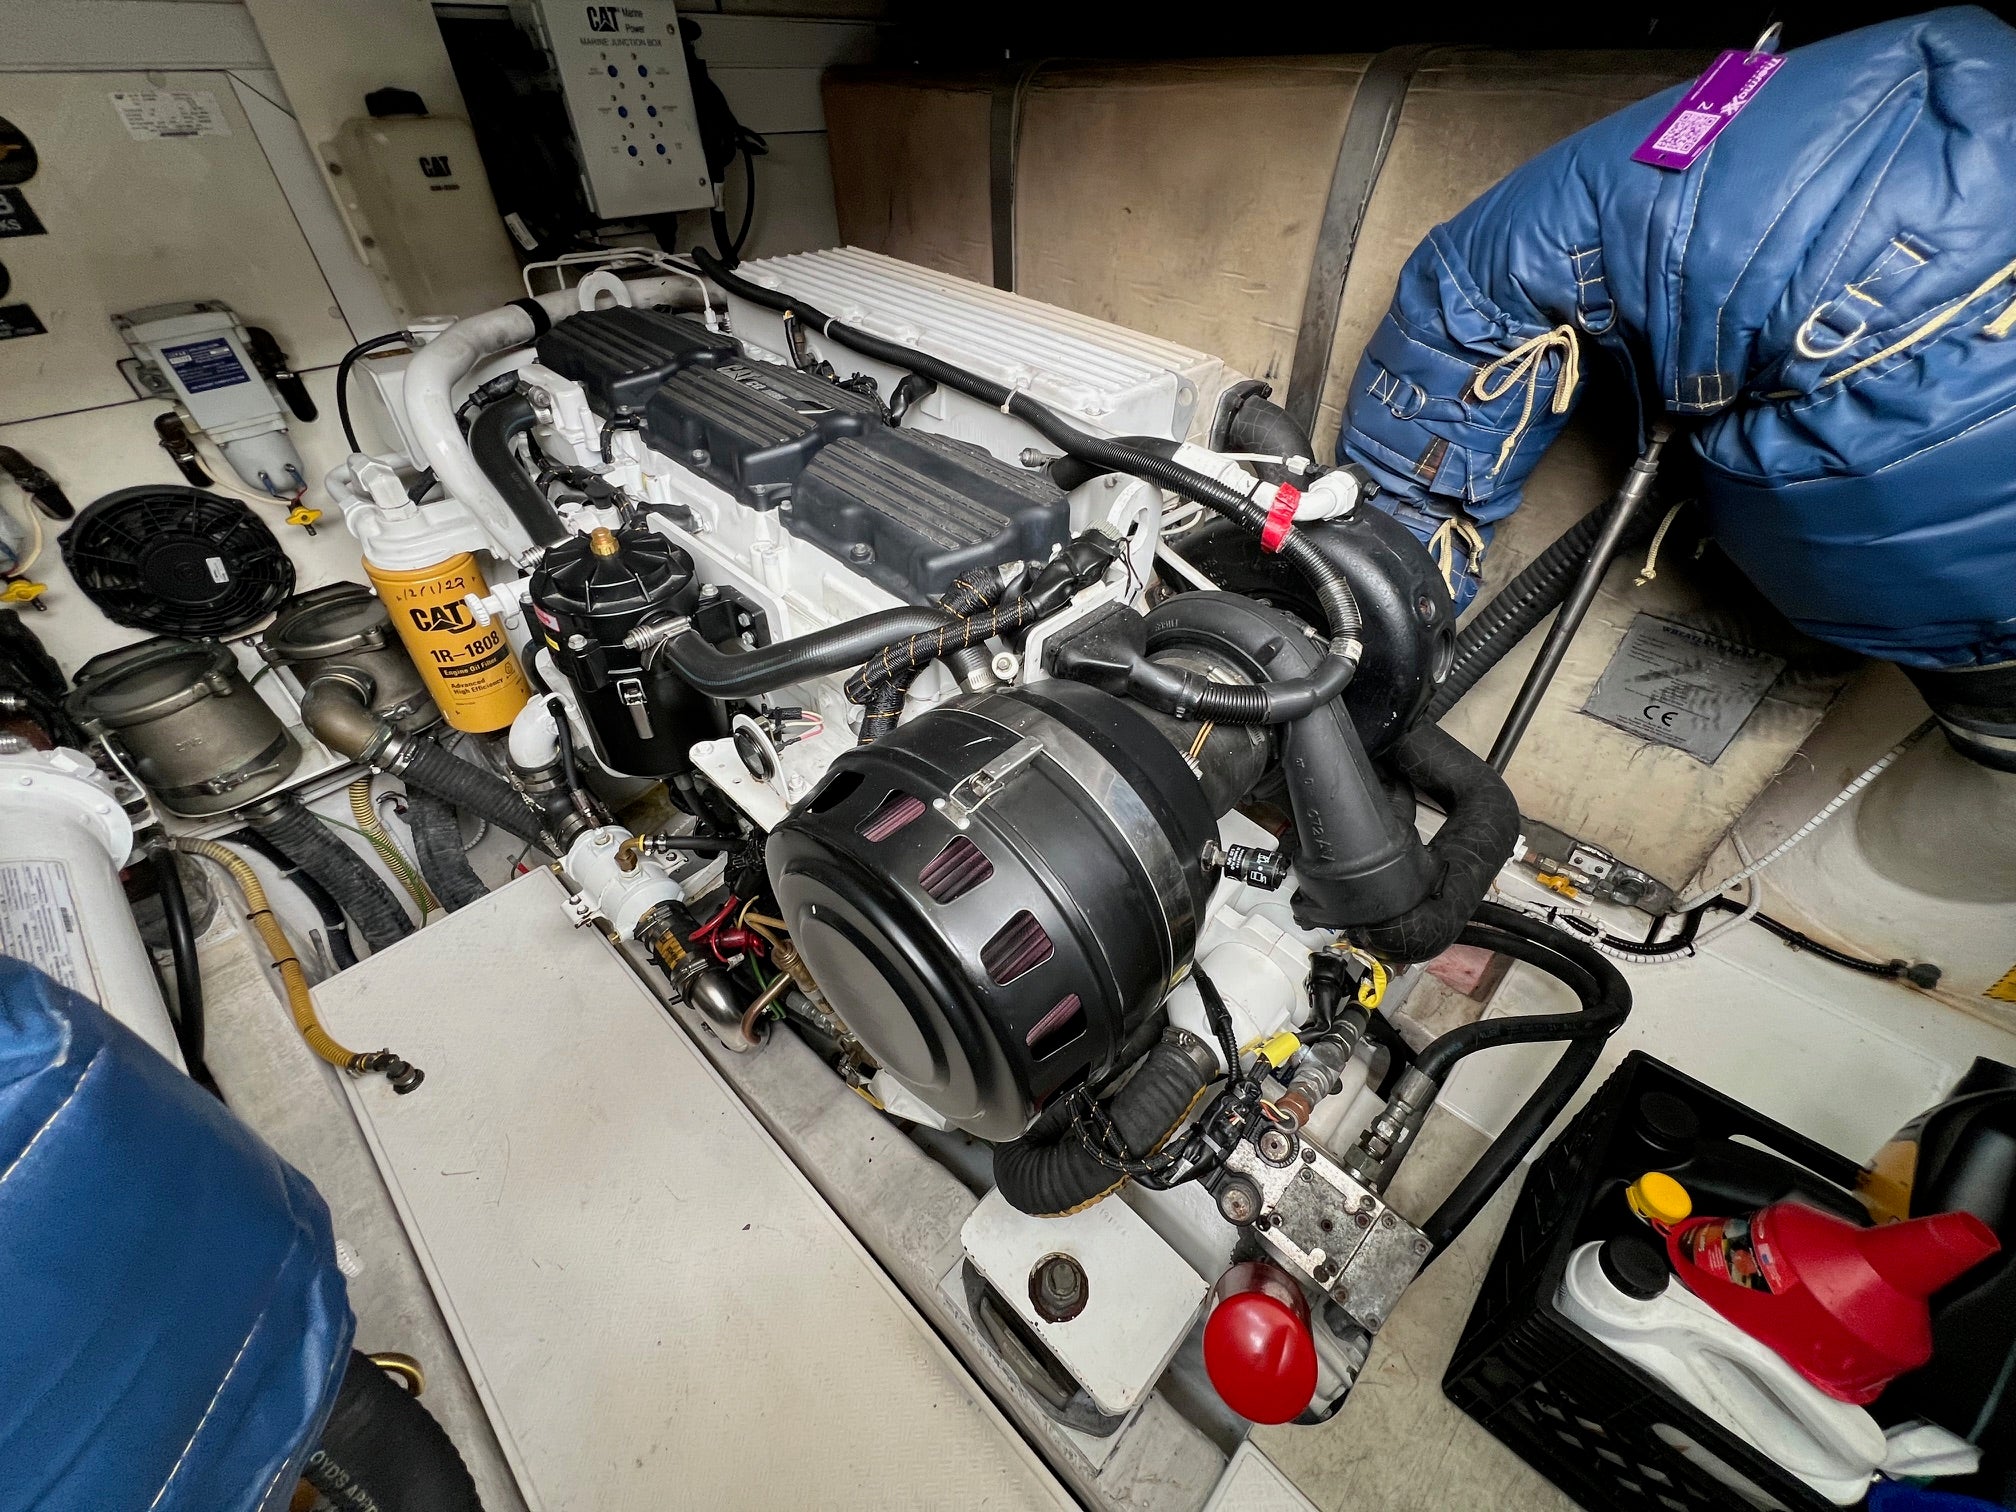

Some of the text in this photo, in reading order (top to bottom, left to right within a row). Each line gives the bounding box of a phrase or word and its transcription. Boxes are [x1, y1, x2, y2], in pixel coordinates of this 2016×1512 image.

[587, 6, 619, 32] CAT
[419, 156, 452, 177] CAT
[409, 600, 468, 633] CAT
[430, 630, 500, 664] 1R-1808
[443, 665, 469, 678] Engine
[469, 662, 481, 674] Oil
[451, 677, 486, 689] Advanced
[453, 685, 471, 696] High
[471, 678, 504, 694] Efficiency
[1643, 704, 1679, 727] CE
